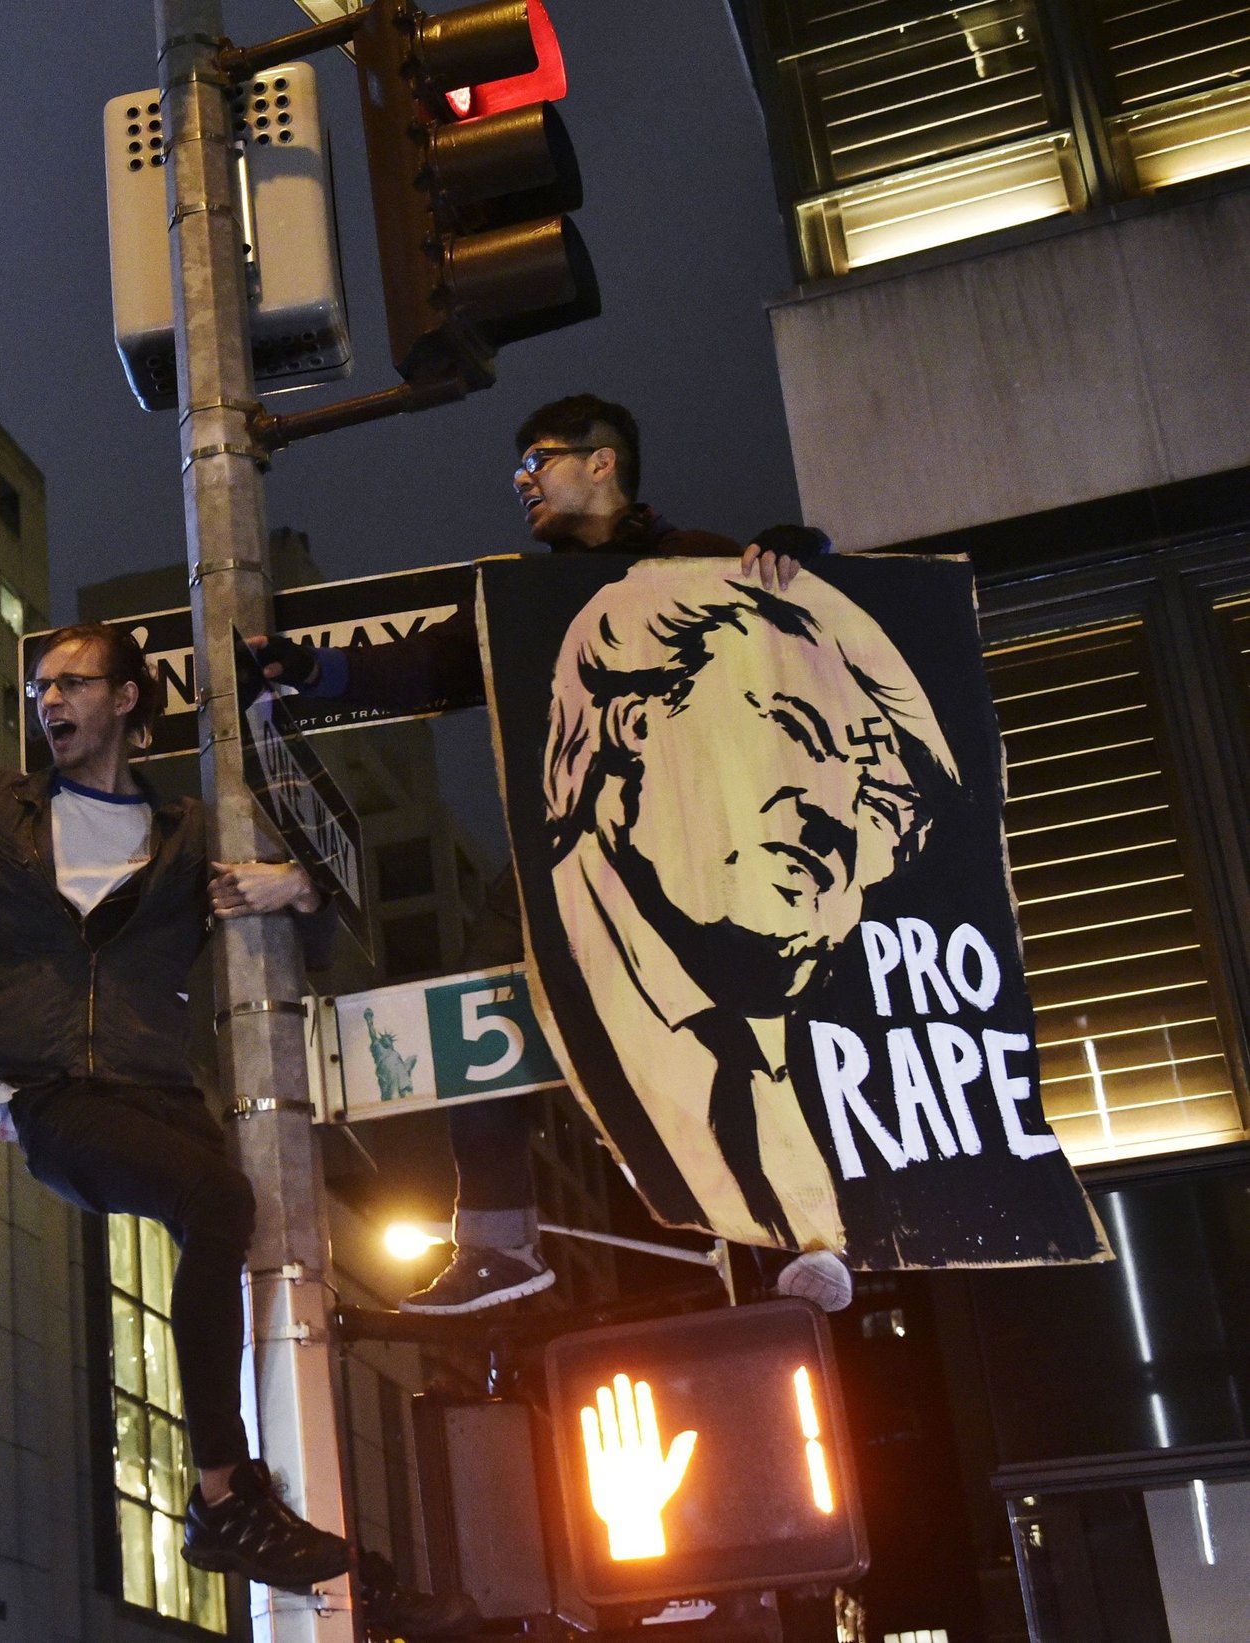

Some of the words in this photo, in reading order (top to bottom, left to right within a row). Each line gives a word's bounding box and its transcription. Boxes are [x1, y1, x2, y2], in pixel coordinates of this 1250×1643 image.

[324, 714, 342, 723] OF
[311, 791, 349, 888] WAY
[860, 917, 1001, 1016] PRO
[460, 986, 525, 1081] 5
[808, 1020, 1061, 1181] RAPE
[793, 1365, 833, 1514] 1
